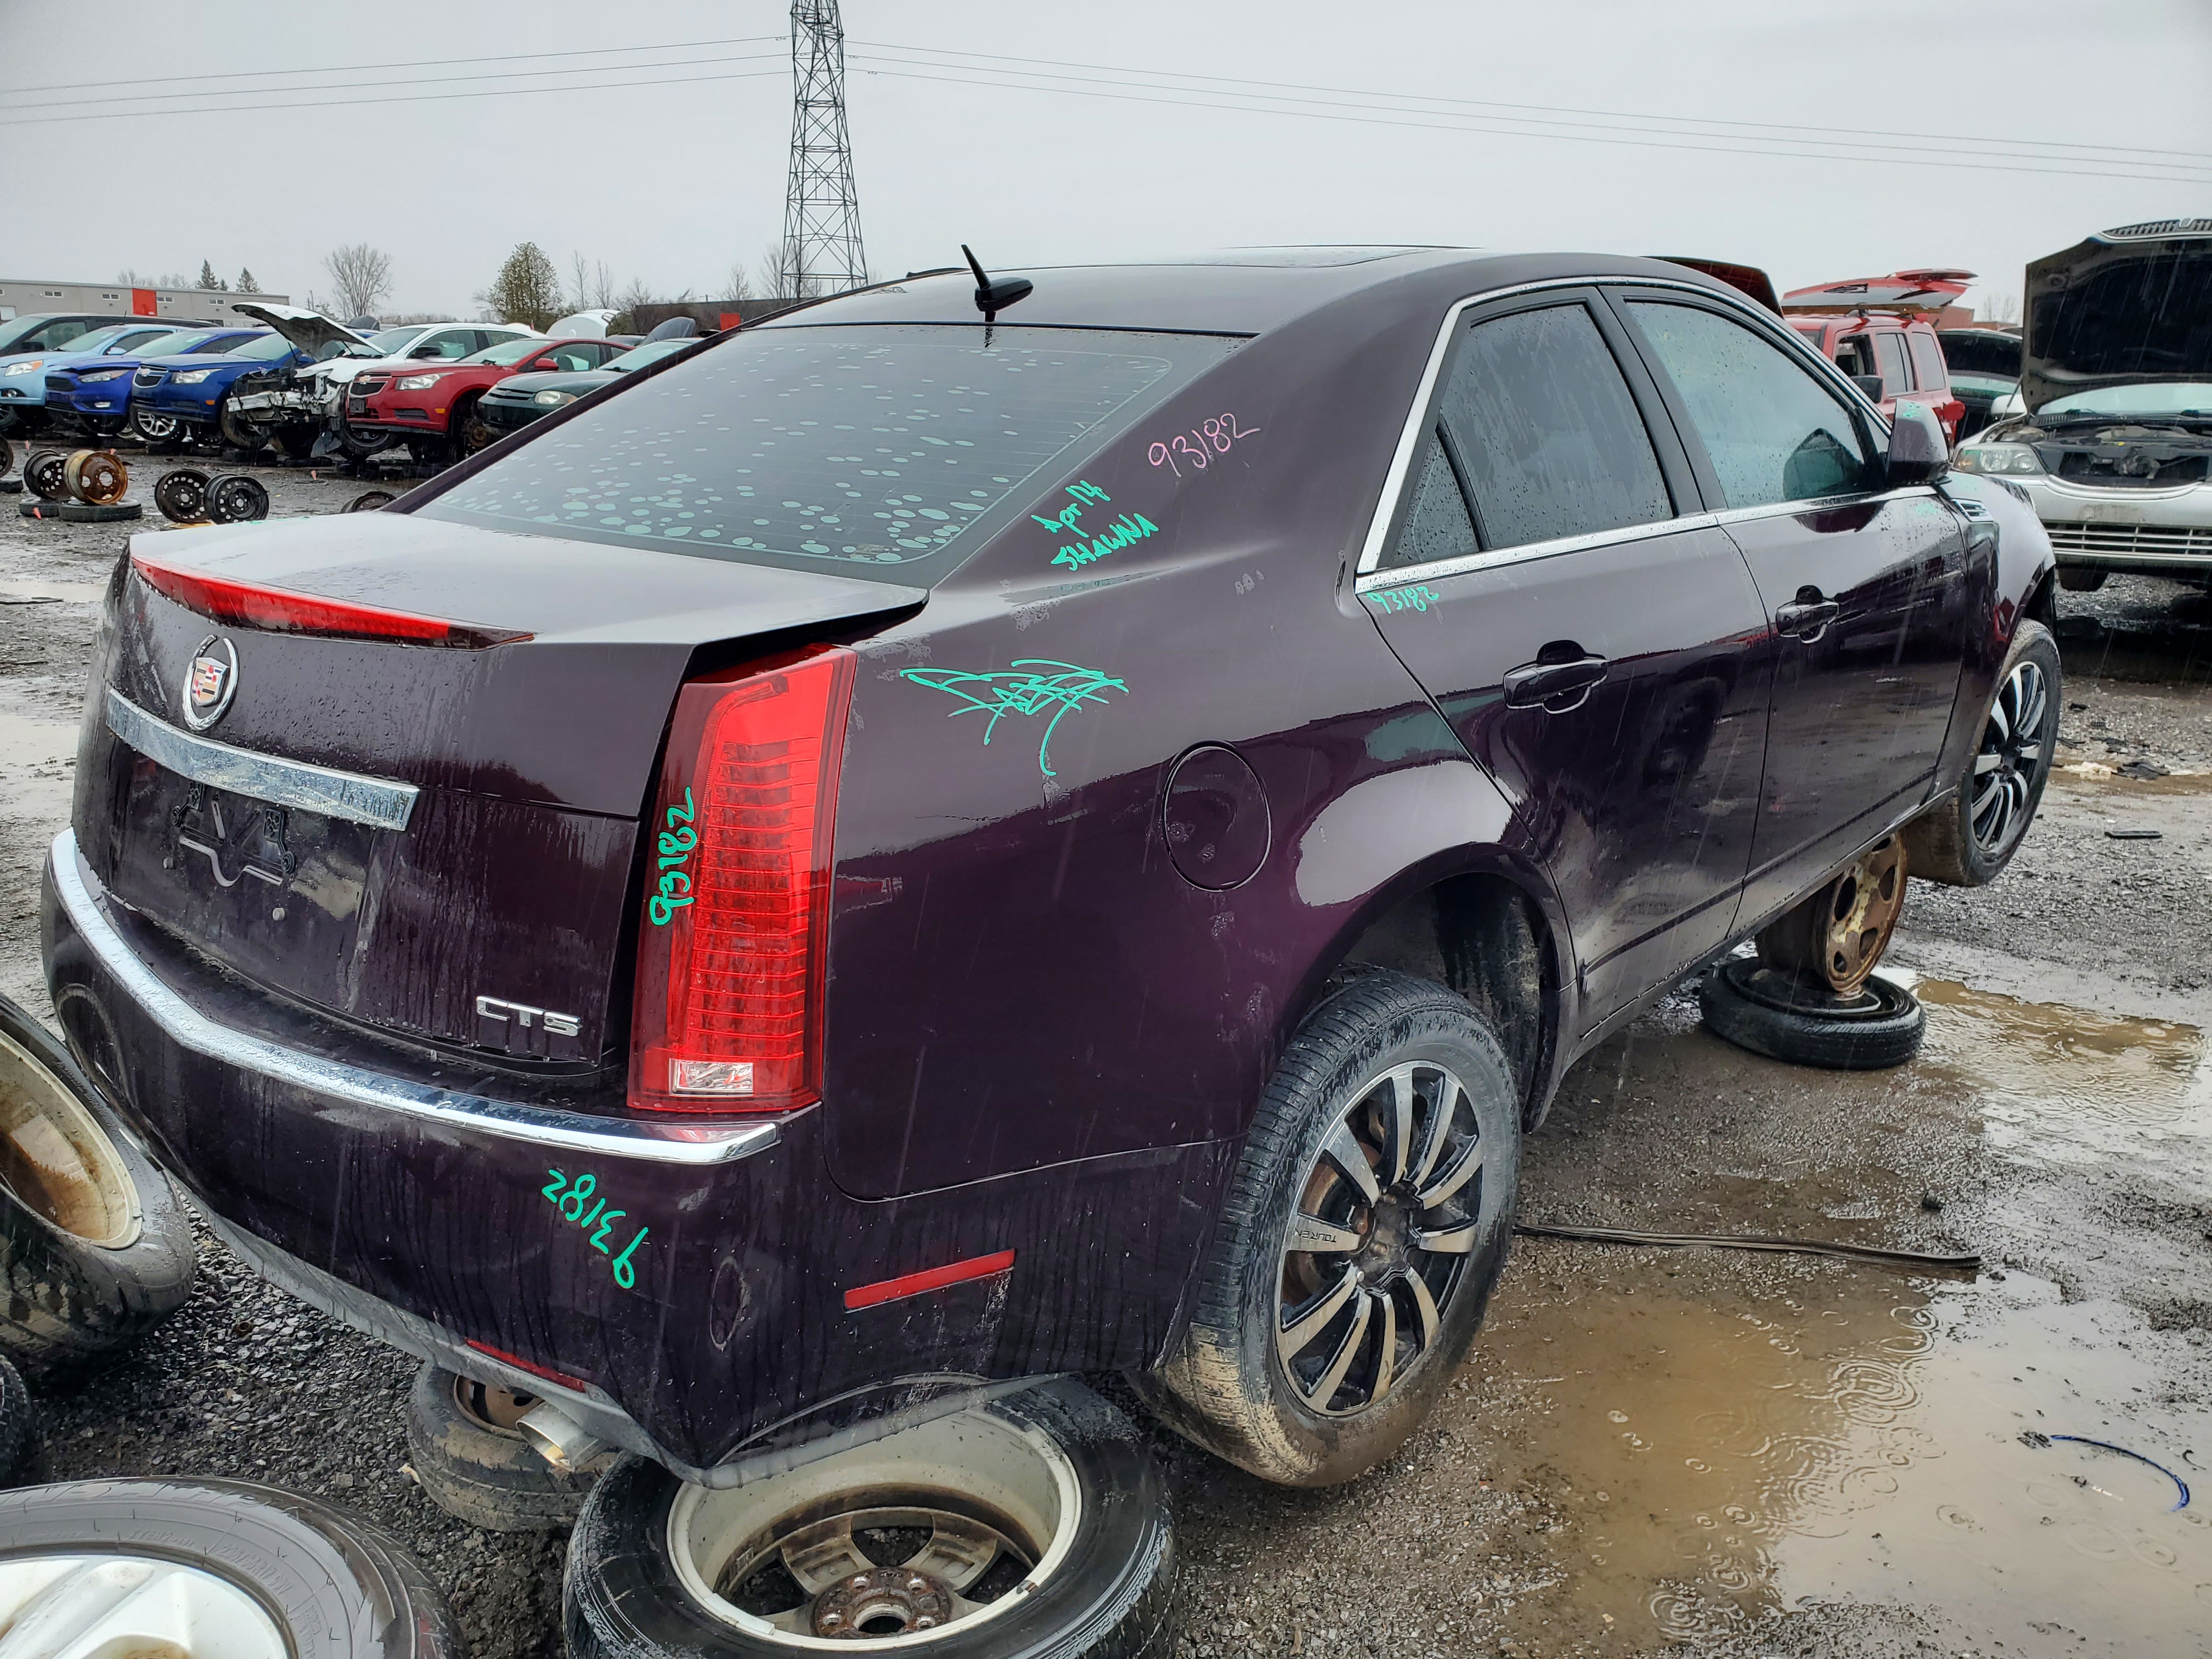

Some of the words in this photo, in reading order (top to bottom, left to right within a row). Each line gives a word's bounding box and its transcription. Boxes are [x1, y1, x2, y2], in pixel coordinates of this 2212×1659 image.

[1148, 413, 1261, 478] 93182
[1050, 513, 1159, 571] SHAWNA
[1365, 586, 1440, 614] 93182
[650, 786, 697, 926] 93182
[476, 995, 582, 1037] CTS
[541, 1169, 649, 1289] 93182
[1295, 1228, 1337, 1243] TOUREN
